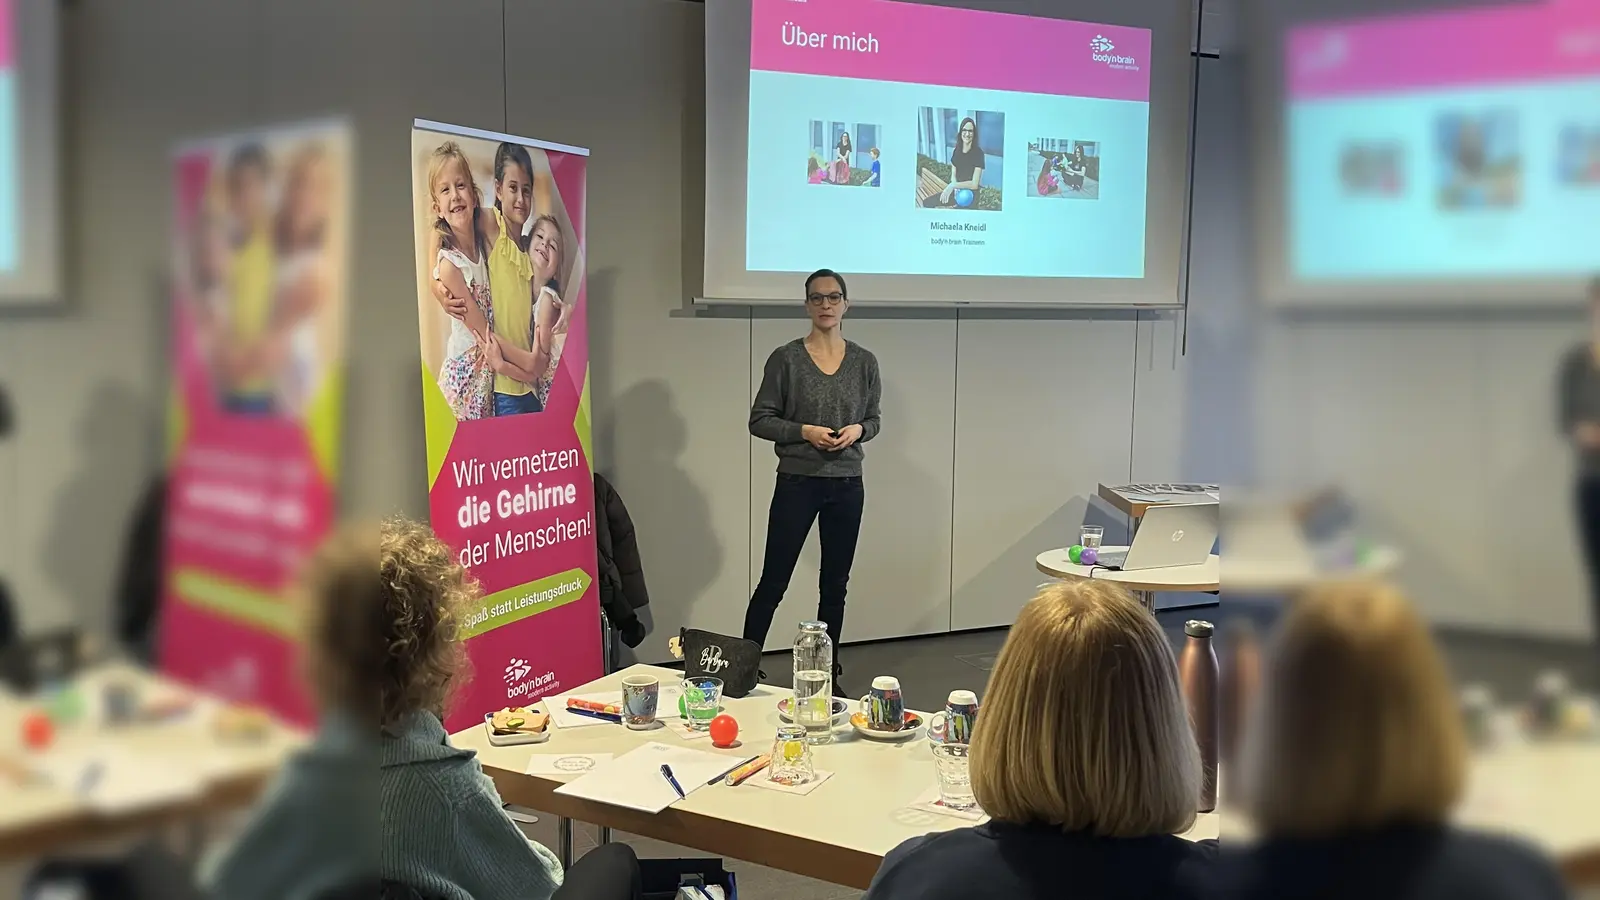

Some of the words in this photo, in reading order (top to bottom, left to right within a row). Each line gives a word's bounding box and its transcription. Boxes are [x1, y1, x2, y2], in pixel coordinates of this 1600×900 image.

[782, 21, 828, 48] Über
[833, 31, 879, 53] mich
[930, 221, 963, 230] Michaela
[964, 223, 987, 231] Kneidl
[452, 459, 486, 488] Wir
[490, 448, 579, 481] vernetzen
[457, 498, 491, 528] die
[496, 482, 577, 519] Gehirne
[459, 538, 490, 569] der
[495, 511, 592, 558] Menschen!
[464, 605, 489, 629] Spaß
[490, 598, 513, 618] statt
[514, 577, 582, 610] Leistungsdruck
[527, 688, 544, 699] modern
[544, 681, 560, 692] activity
[535, 671, 555, 687] brain
